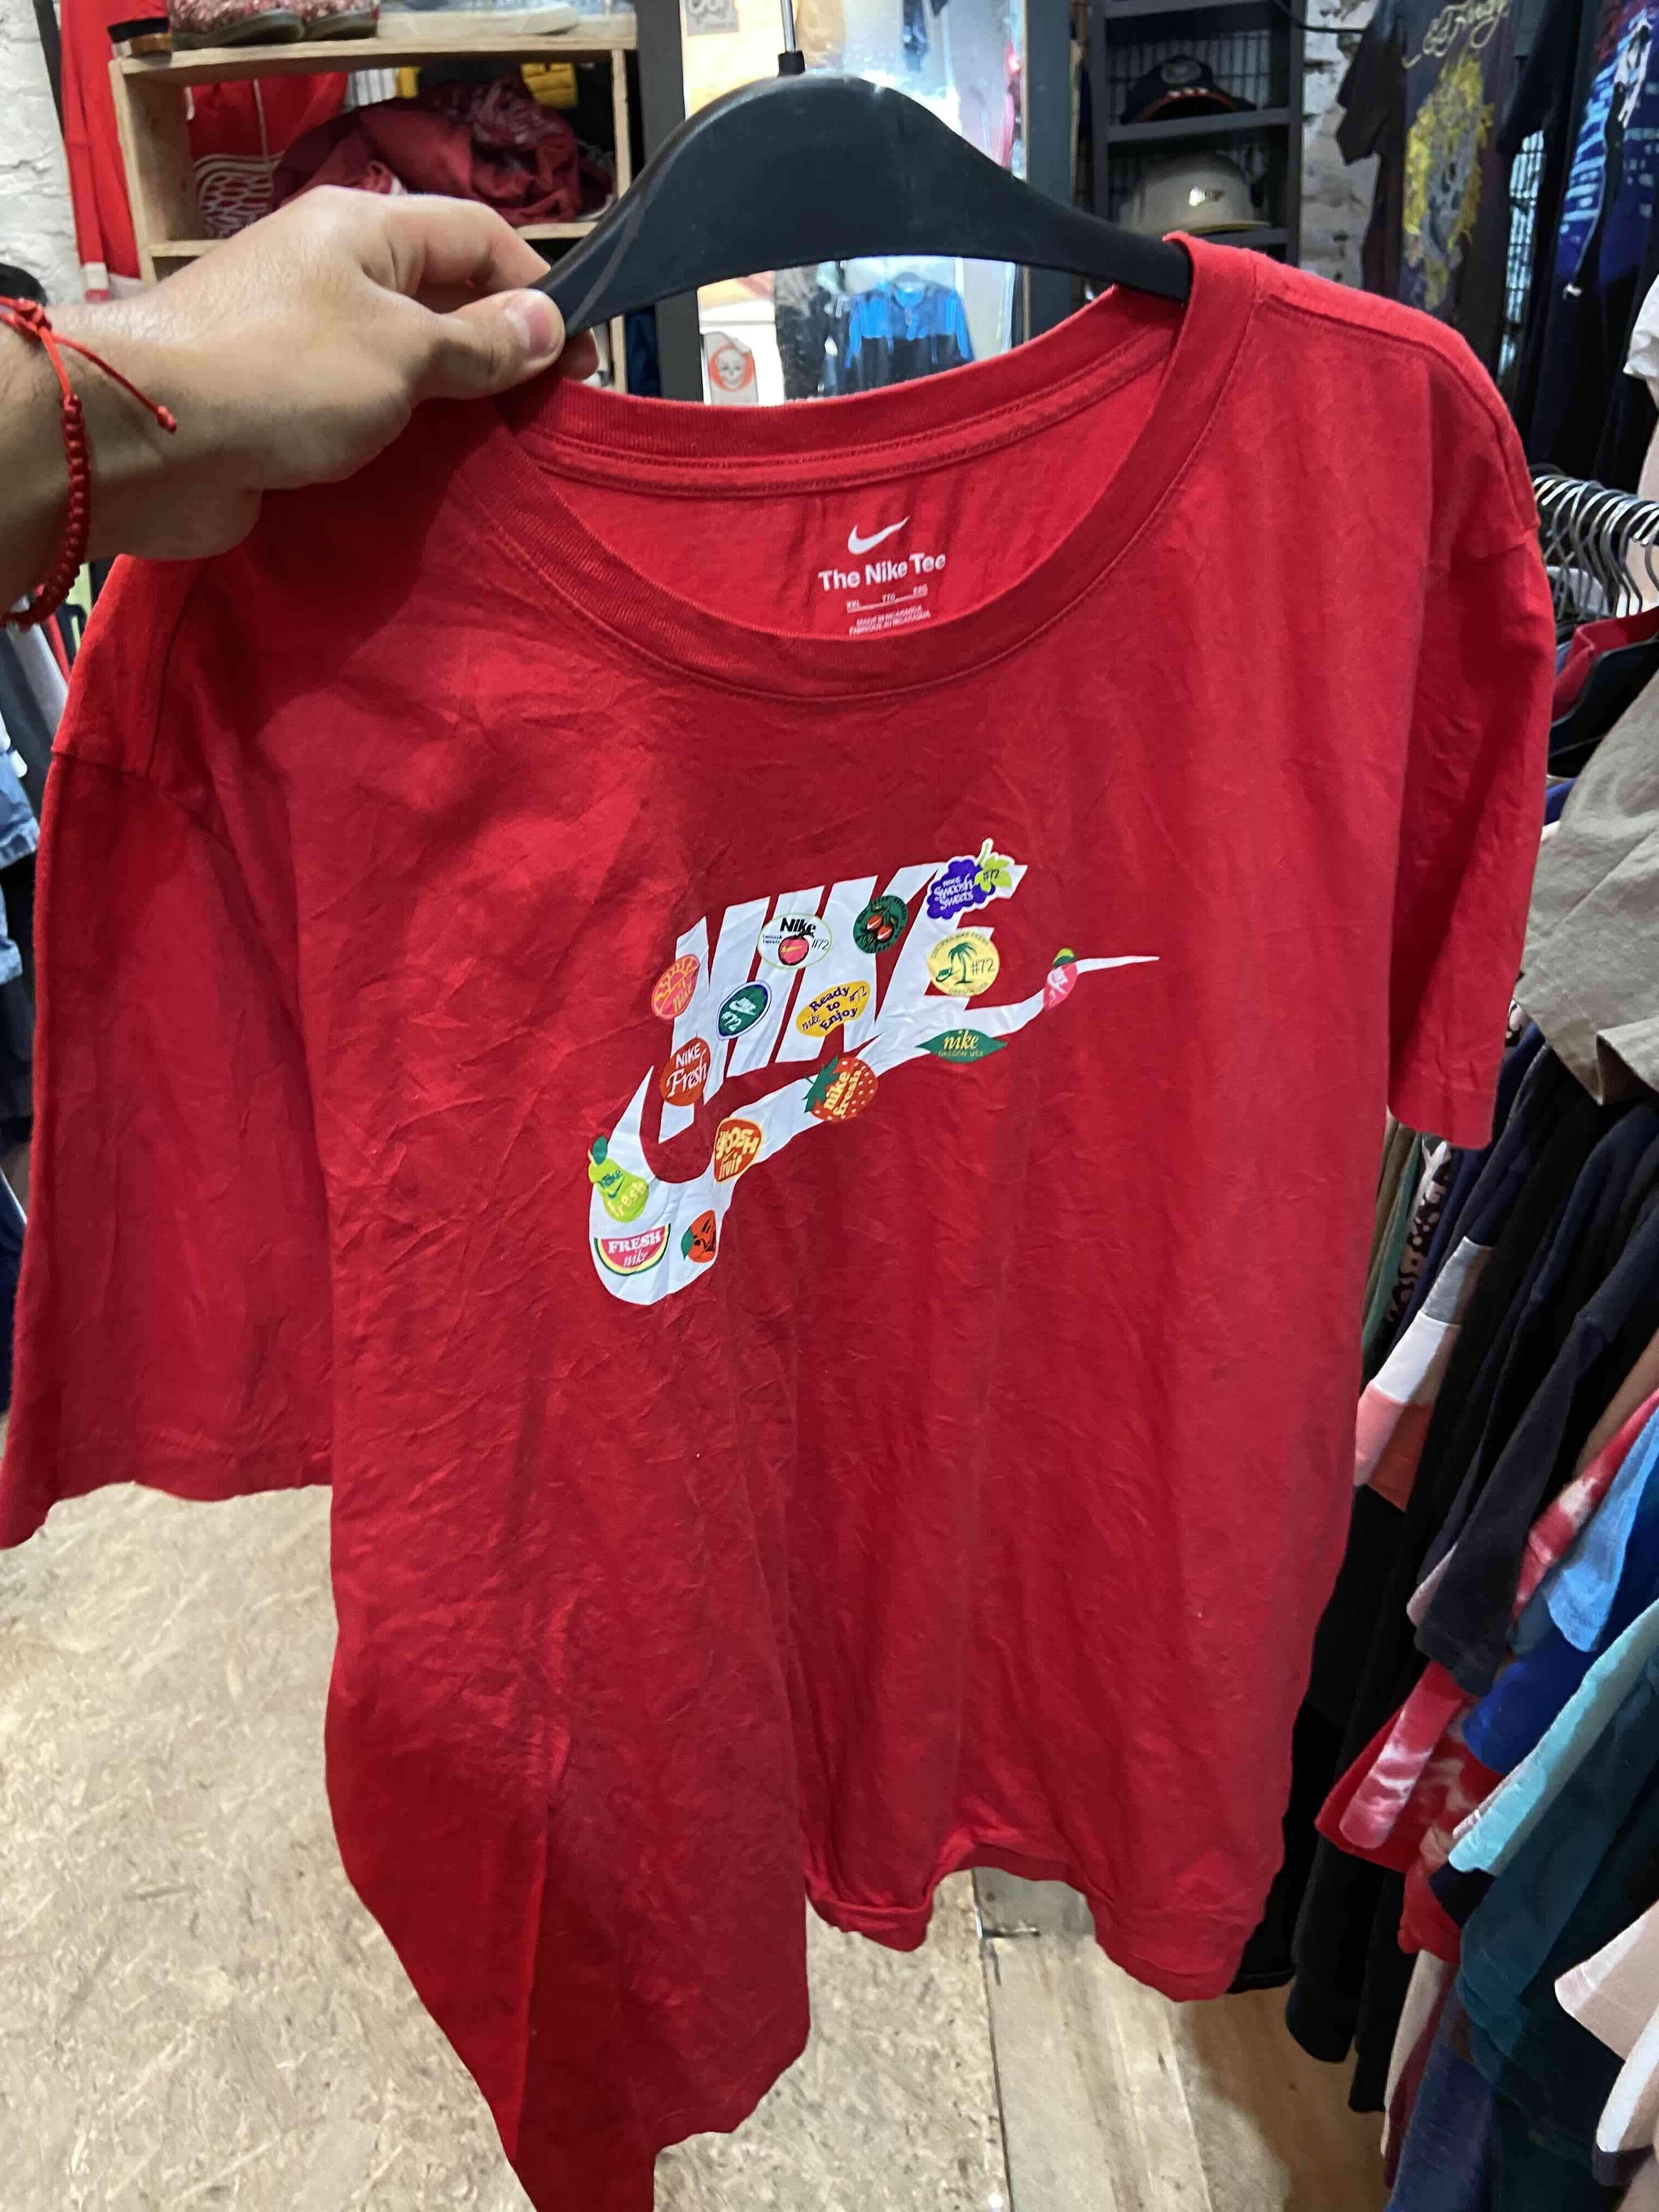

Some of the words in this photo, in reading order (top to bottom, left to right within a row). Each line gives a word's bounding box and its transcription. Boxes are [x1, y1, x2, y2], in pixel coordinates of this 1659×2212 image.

[817, 569, 860, 591] The
[865, 561, 907, 585] Nike
[910, 553, 946, 574] Tee
[780, 917, 816, 933] Nike
[971, 958, 996, 975] #72
[809, 987, 850, 1012] Ready
[826, 1002, 840, 1011] to
[820, 1008, 858, 1031] Enjoy
[944, 1029, 979, 1049] nike
[676, 1042, 701, 1069] NIKE
[666, 1048, 707, 1098] Fresh
[823, 1071, 850, 1110] nike
[832, 1070, 861, 1115] fresh
[608, 1230, 661, 1254] FRESH
